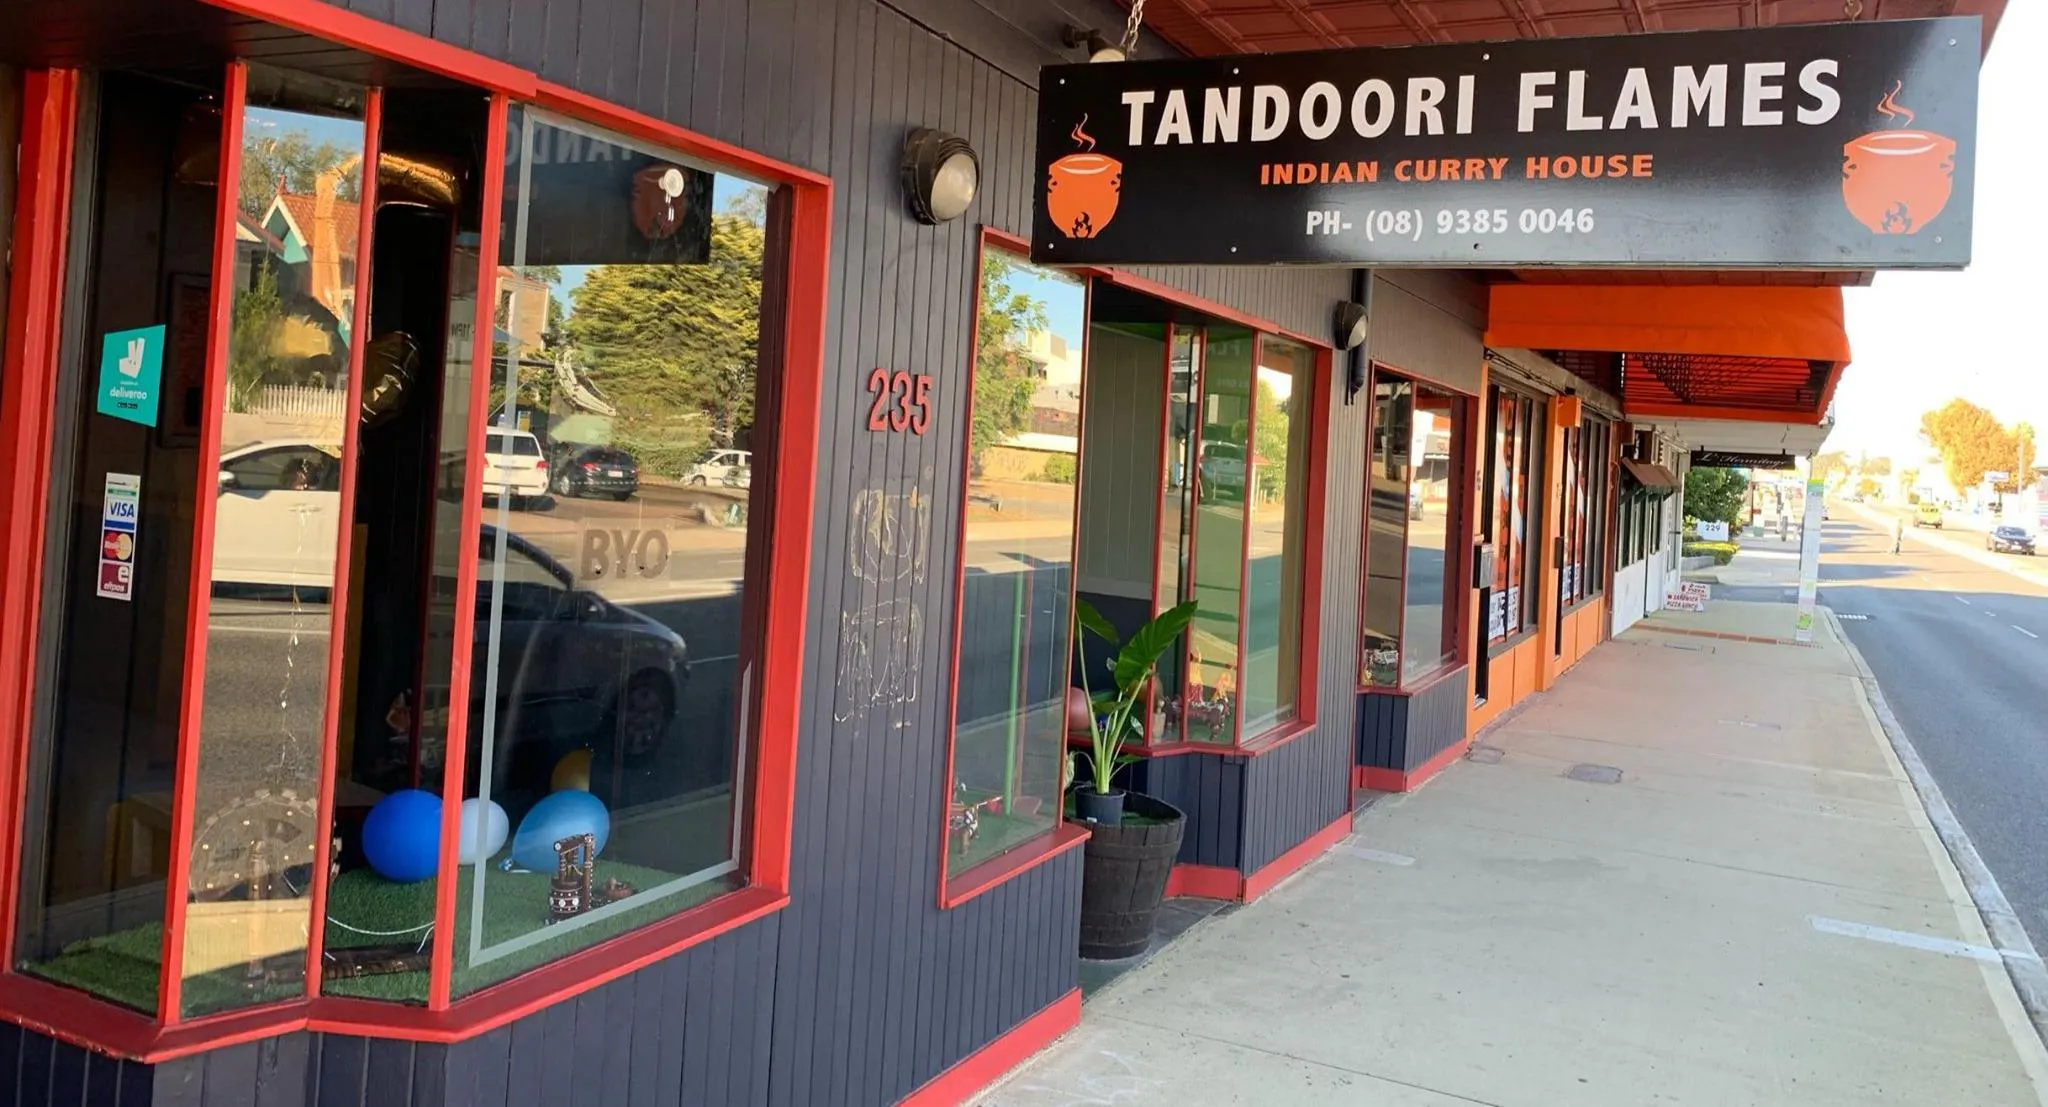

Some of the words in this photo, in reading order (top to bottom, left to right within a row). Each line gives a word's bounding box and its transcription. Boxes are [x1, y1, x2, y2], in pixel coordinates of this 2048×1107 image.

[1121, 75, 1475, 145] TANDOORI
[1517, 58, 1842, 132] FLAMES
[1260, 162, 1378, 185] INDIAN
[1395, 158, 1507, 182] CURRY
[1526, 154, 1654, 178] HOUSE
[1305, 210, 1352, 235] PH-
[1366, 209, 1424, 241] (08)
[1437, 209, 1508, 234] 9385
[1519, 208, 1595, 233] 0046
[109, 386, 148, 400] deliveroo
[867, 367, 933, 435] 235
[109, 501, 135, 518] VISA
[1705, 524, 1721, 532] 229
[581, 529, 671, 580] BYO
